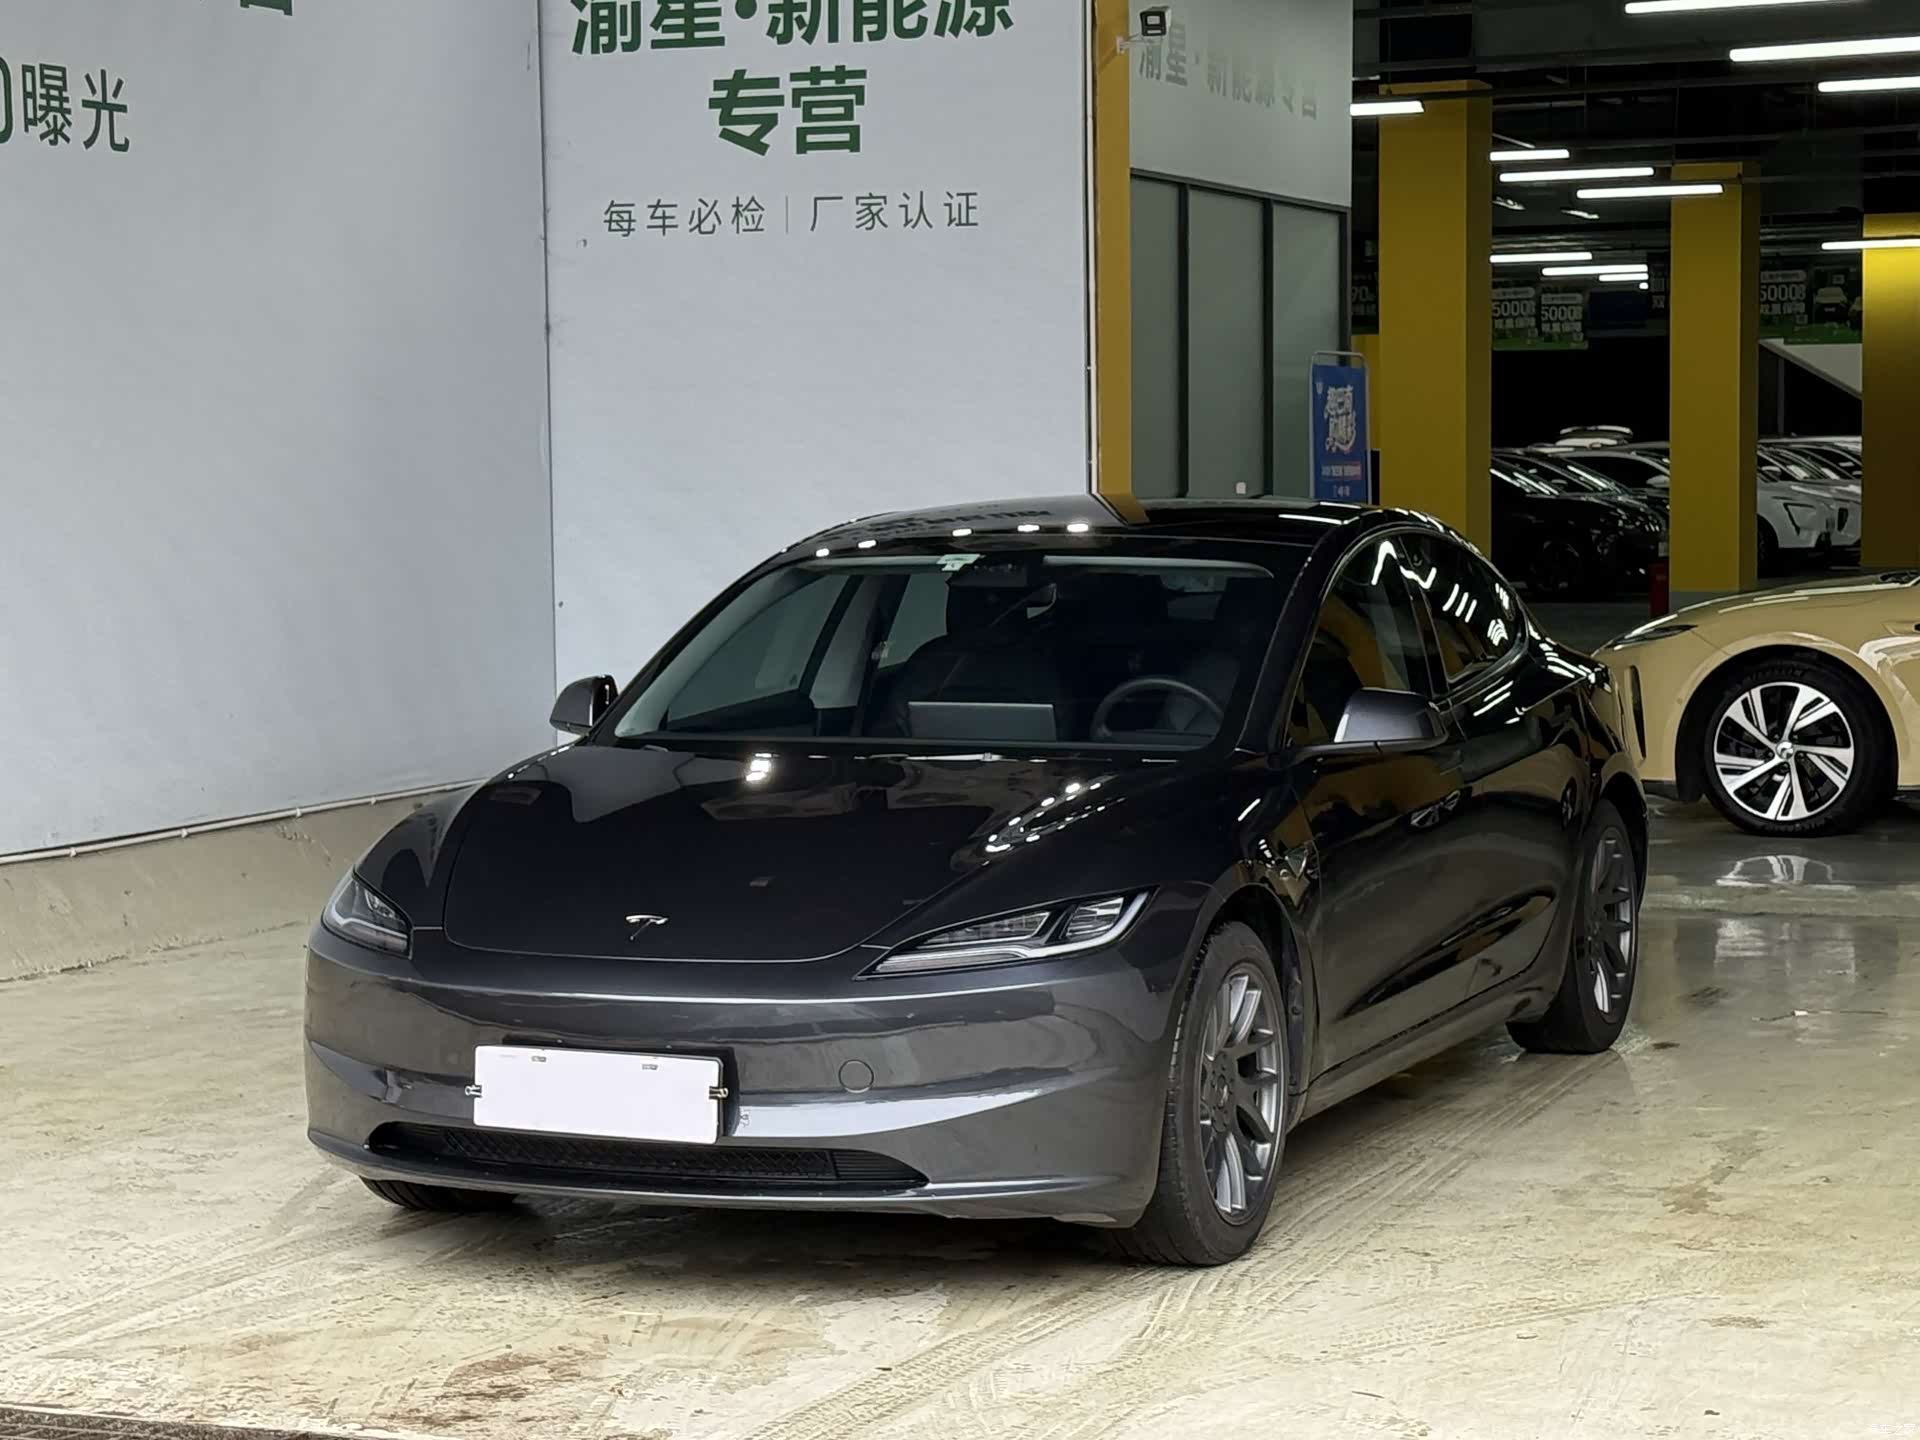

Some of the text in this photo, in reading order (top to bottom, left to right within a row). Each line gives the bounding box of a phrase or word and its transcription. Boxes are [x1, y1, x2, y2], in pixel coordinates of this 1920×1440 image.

[708, 64, 868, 157] 专营
[603, 190, 980, 238] 每车必检 厂家认证
